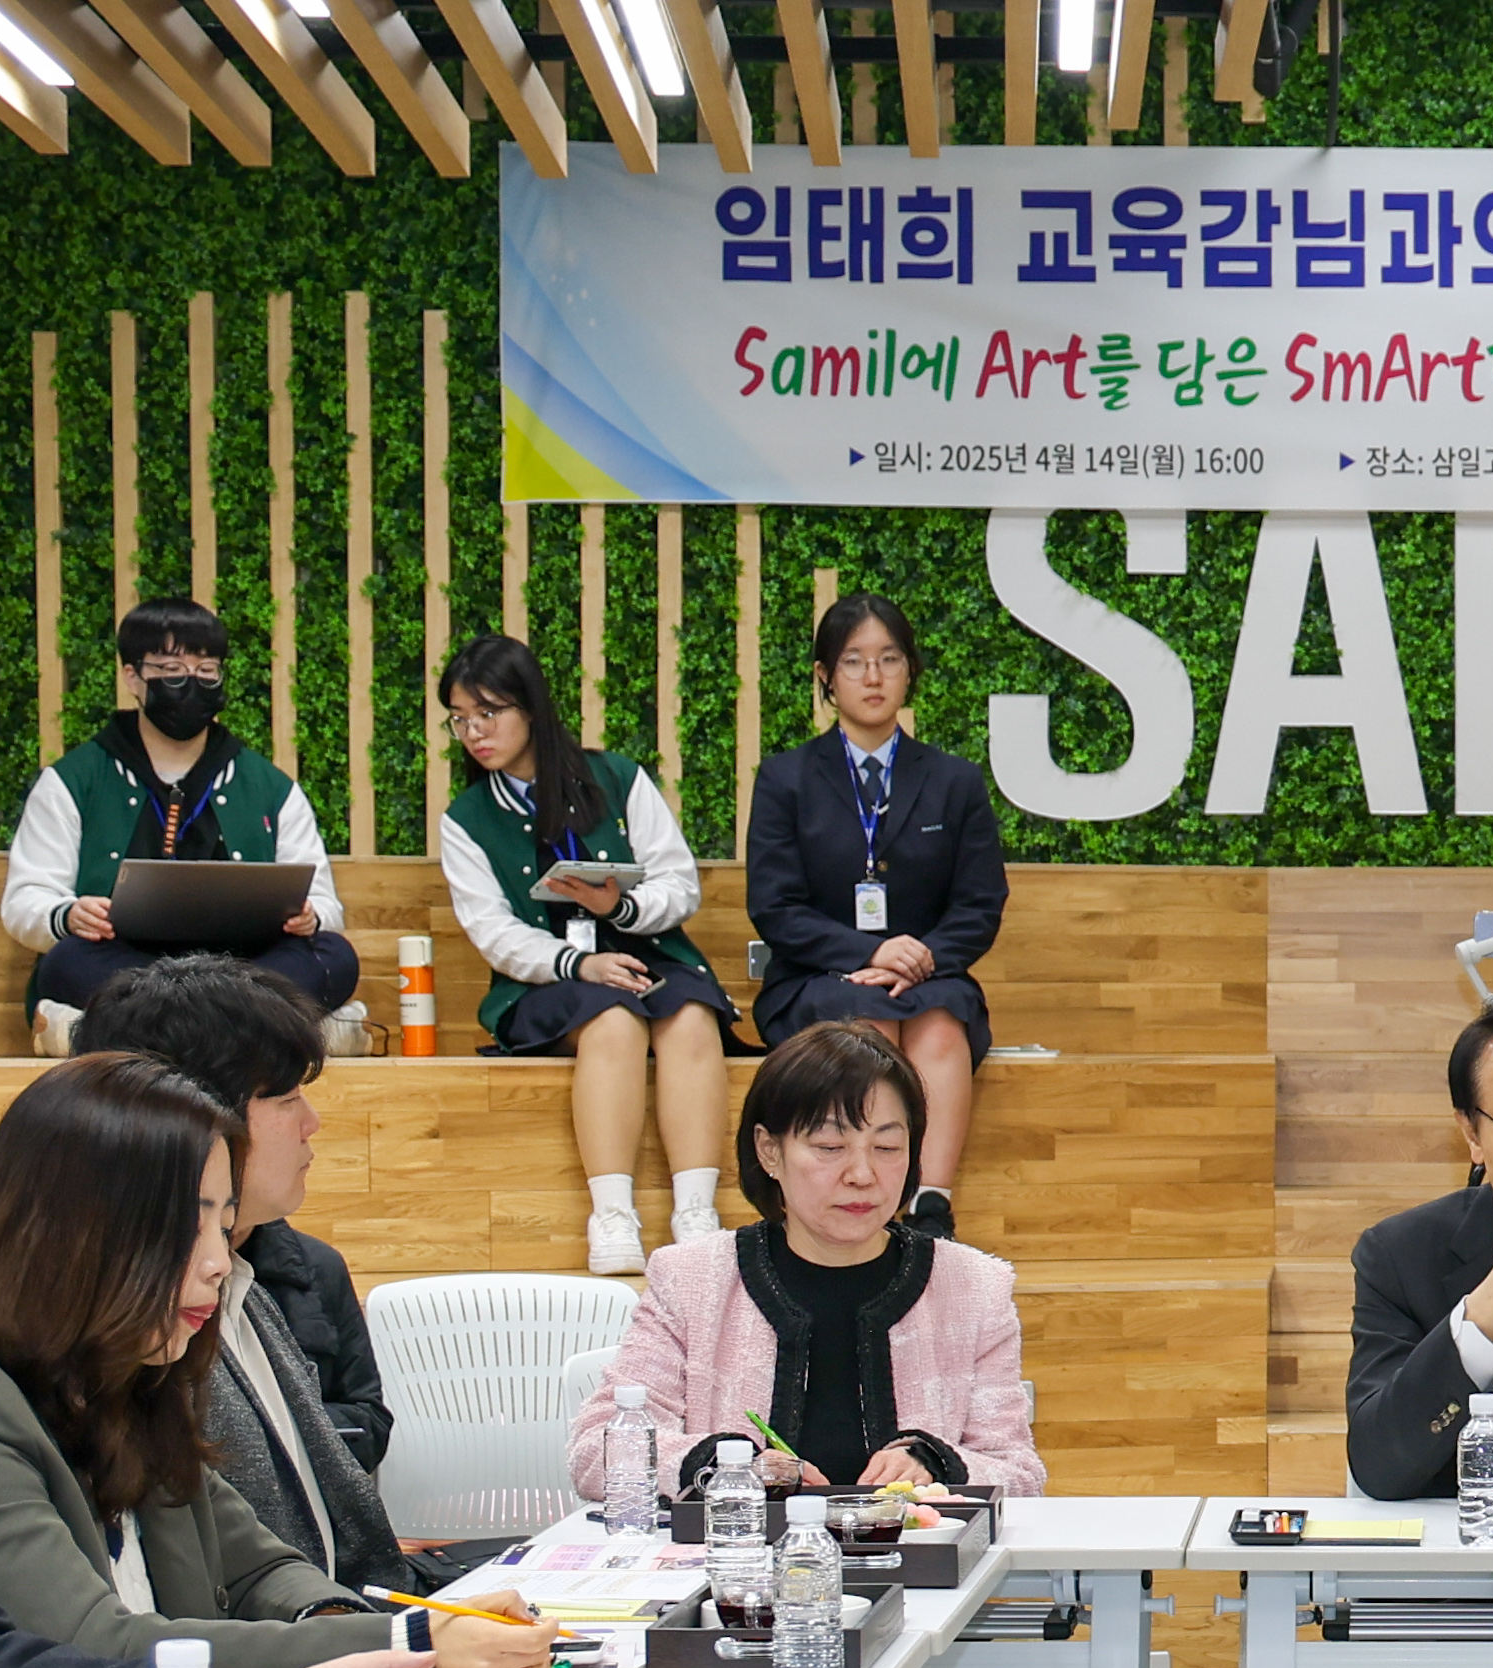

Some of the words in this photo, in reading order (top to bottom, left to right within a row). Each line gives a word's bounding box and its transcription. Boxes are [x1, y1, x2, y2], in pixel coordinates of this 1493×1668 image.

[715, 186, 973, 286] 임태희
[735, 326, 960, 402] Samil에
[975, 330, 1142, 410] Art를
[1157, 337, 1268, 408] 담은
[875, 442, 932, 474] 일시:
[940, 443, 1026, 475] 2025년
[1036, 444, 1075, 475] 4월
[1085, 445, 1185, 480] 14일(월)
[1195, 447, 1264, 475] 16:00
[1367, 446, 1422, 478] 장소:
